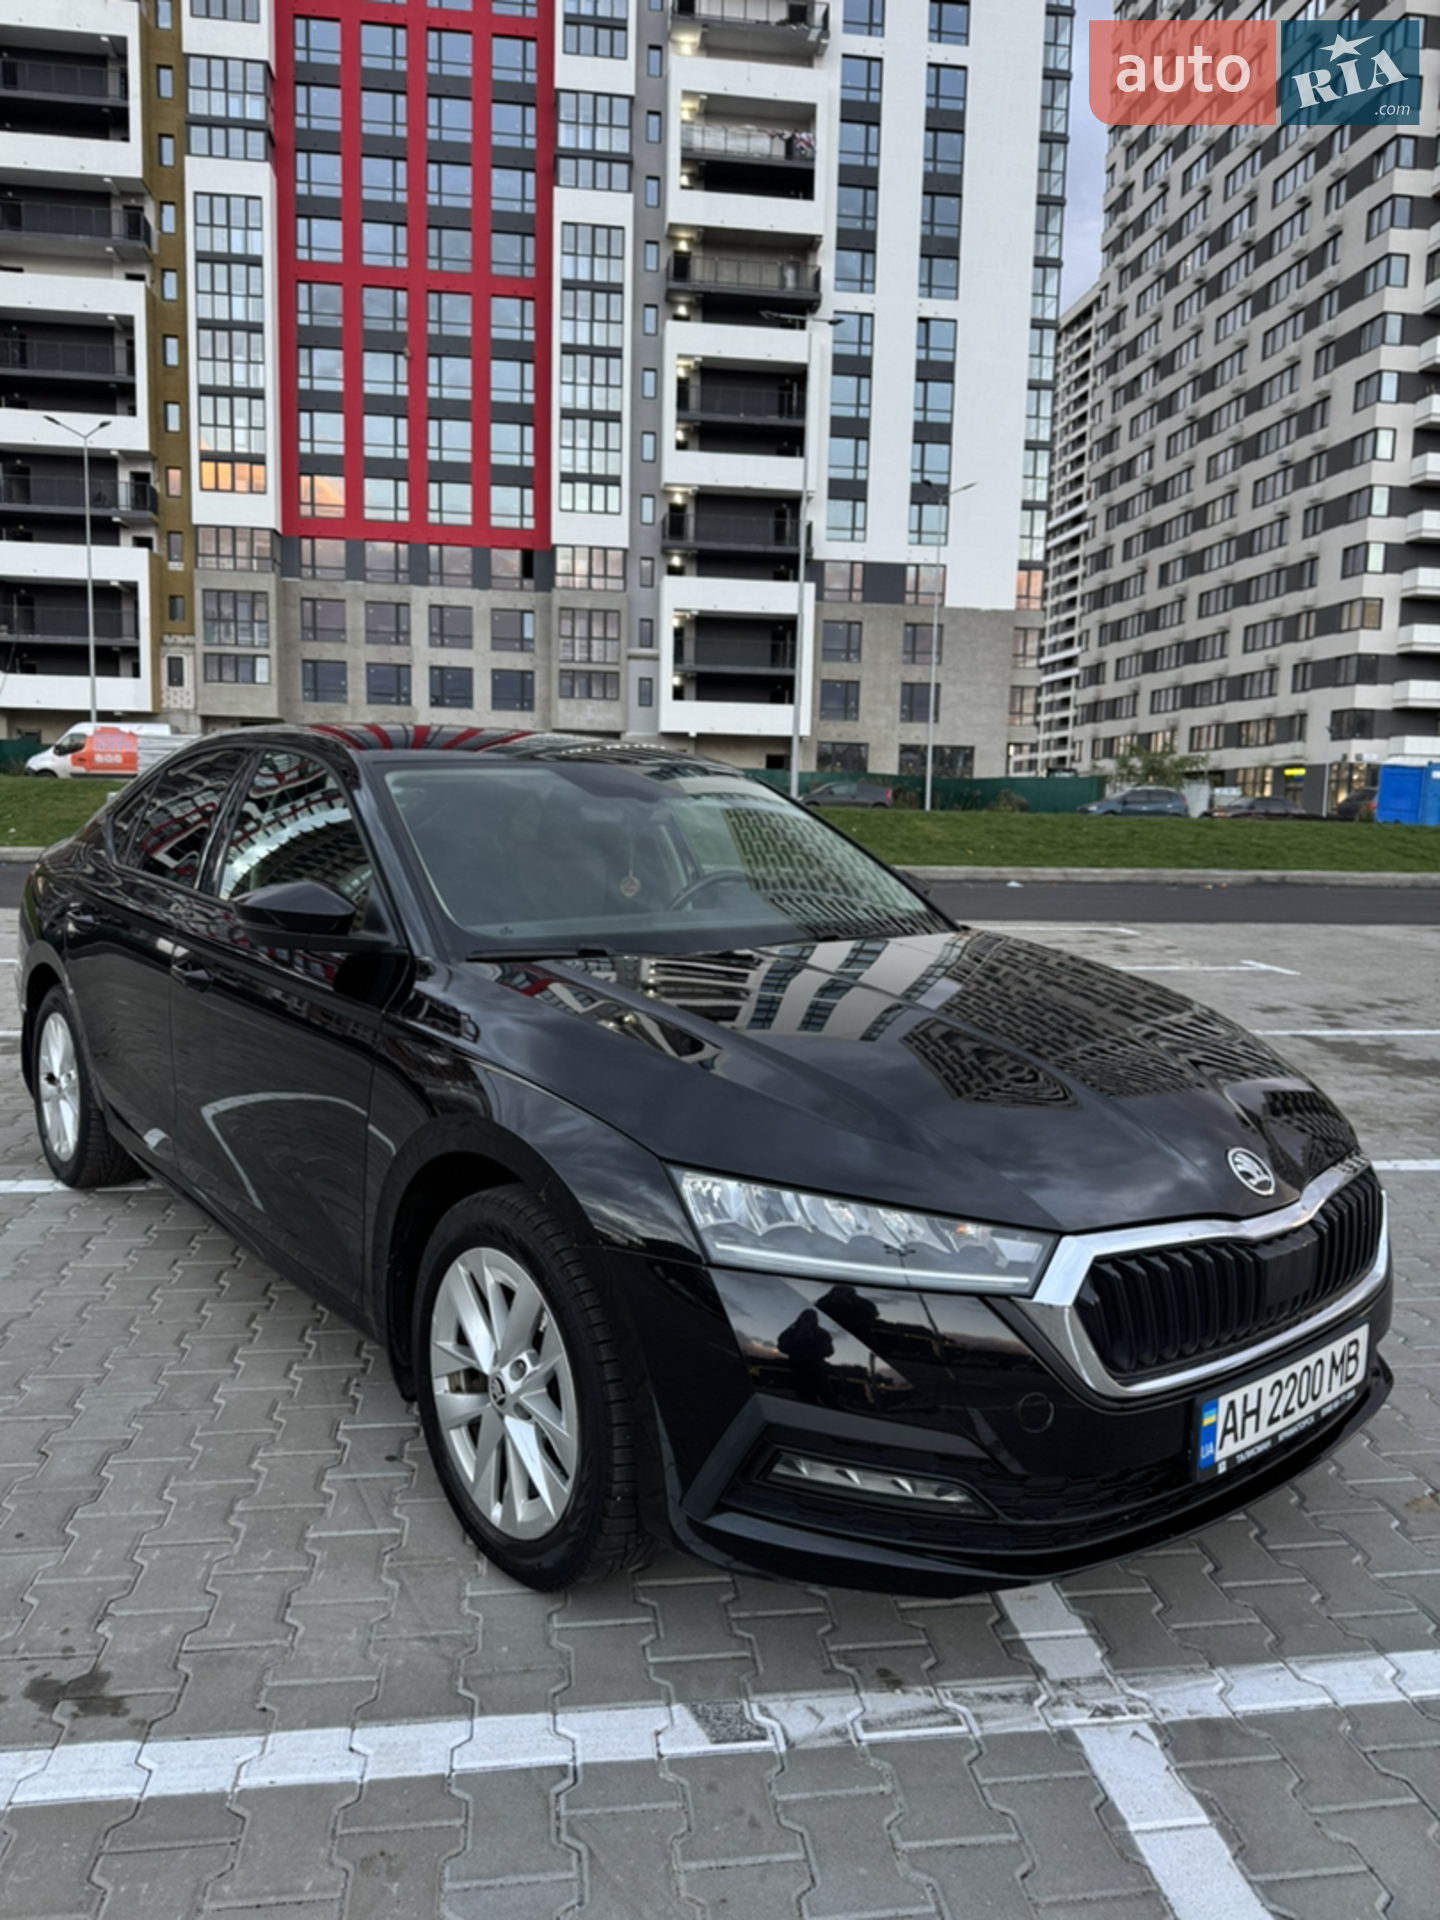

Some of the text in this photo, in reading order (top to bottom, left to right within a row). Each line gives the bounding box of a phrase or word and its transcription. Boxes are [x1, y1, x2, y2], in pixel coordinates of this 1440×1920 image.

[1218, 1387, 1263, 1451] AH
[1267, 1358, 1324, 1427] 2200
[1328, 1338, 1360, 1393] MB
[1200, 1441, 1214, 1459] UA
